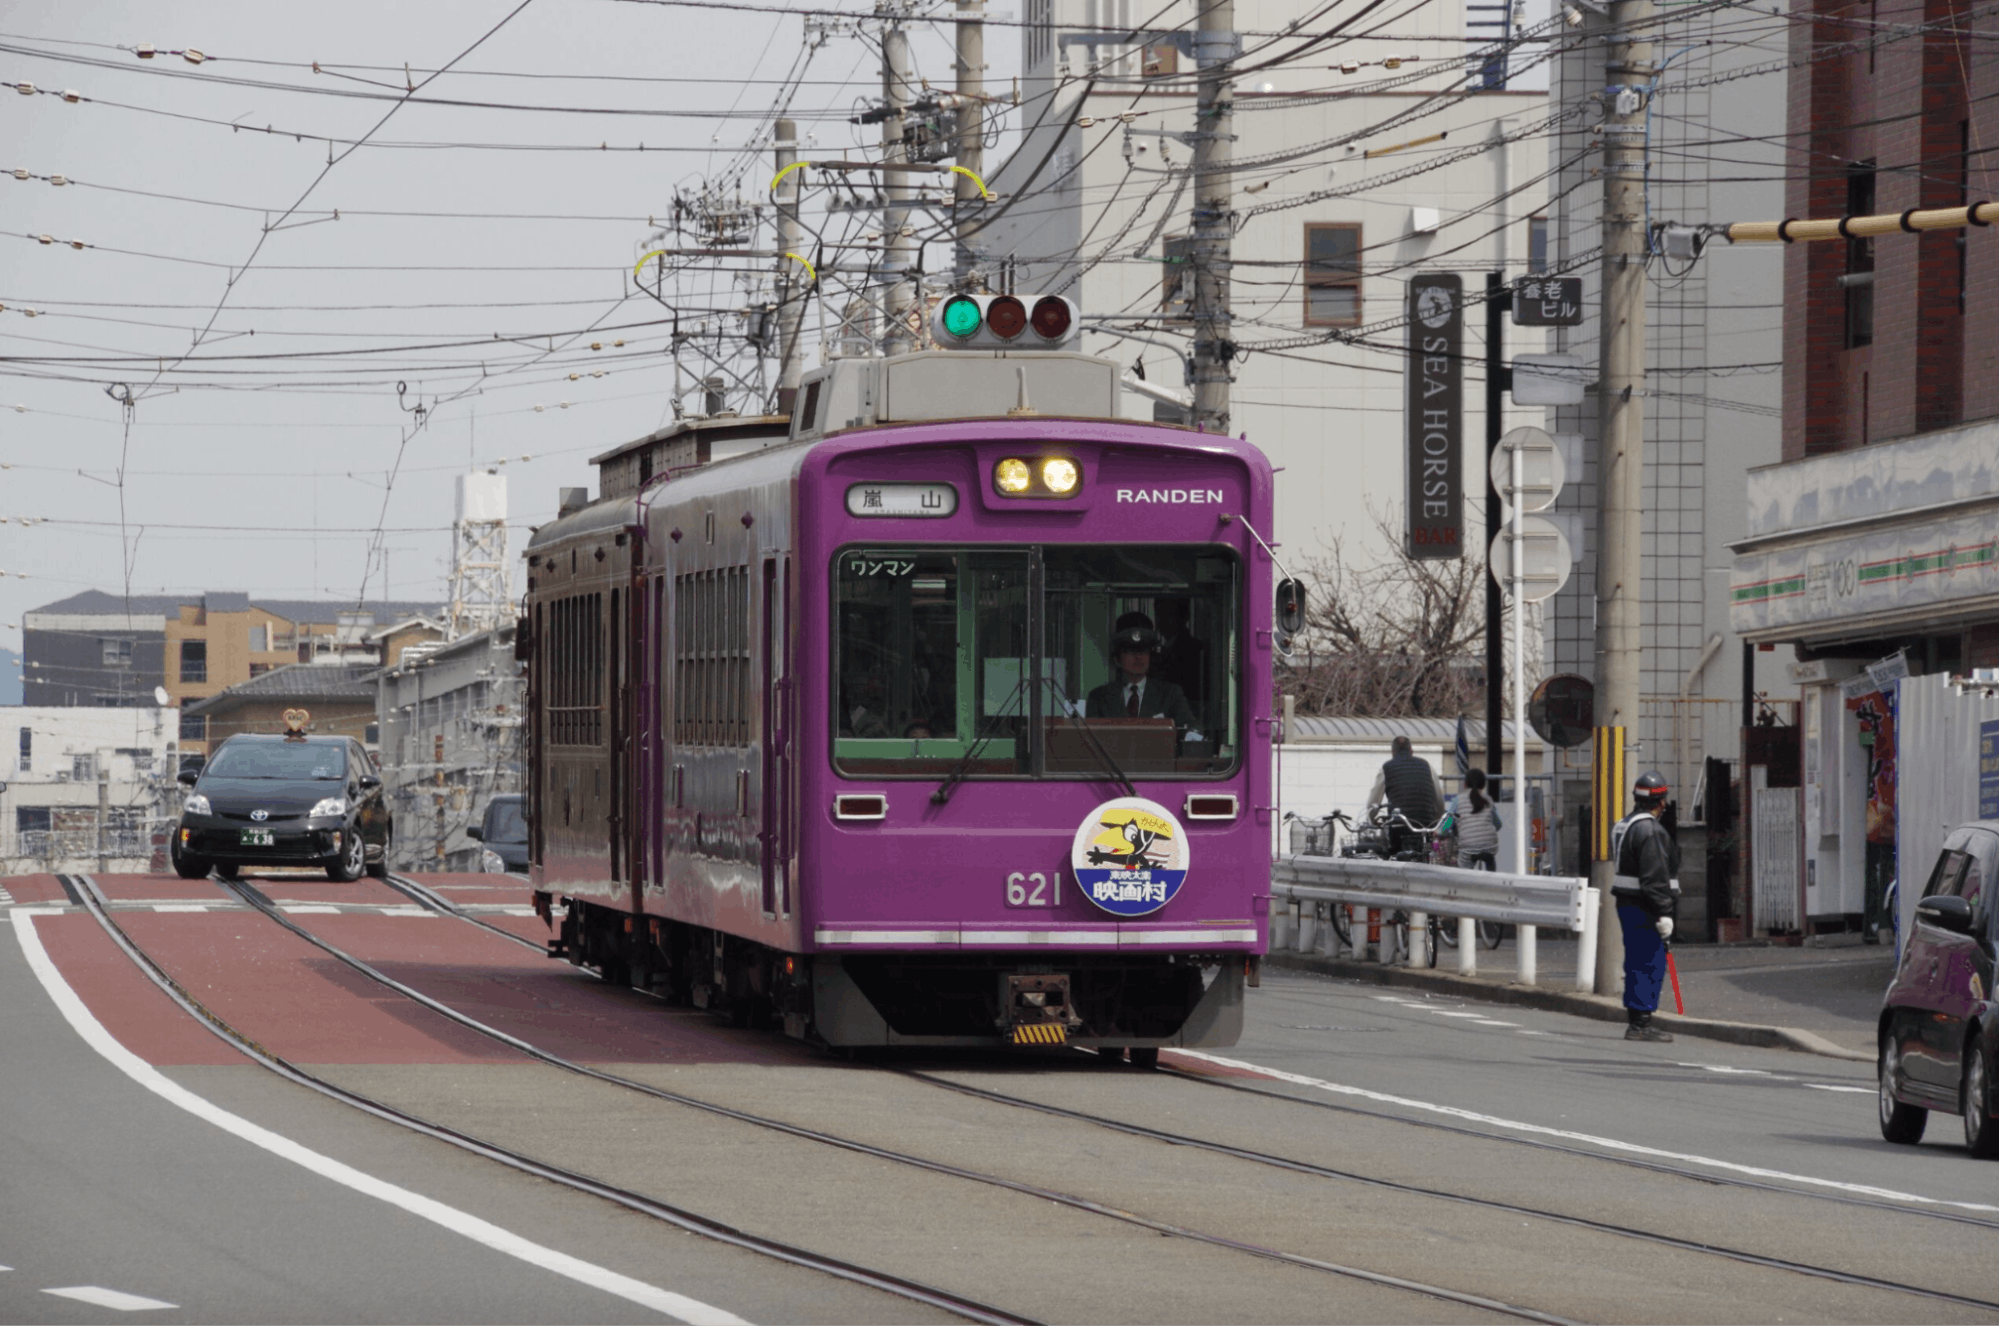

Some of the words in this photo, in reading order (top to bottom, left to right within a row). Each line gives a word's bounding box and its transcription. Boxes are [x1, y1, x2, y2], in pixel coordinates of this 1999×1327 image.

[1523, 281, 1562, 300] 養老
[1541, 301, 1577, 318] ビル
[1423, 337, 1448, 399] SEA
[1423, 409, 1448, 519] HORSE
[863, 489, 941, 508] 嵐山
[1117, 489, 1223, 503] RANDEN
[1415, 528, 1458, 545] BAR
[851, 561, 915, 576] ワンマン
[1007, 872, 1060, 906] 621
[1093, 880, 1167, 902] 映画村
